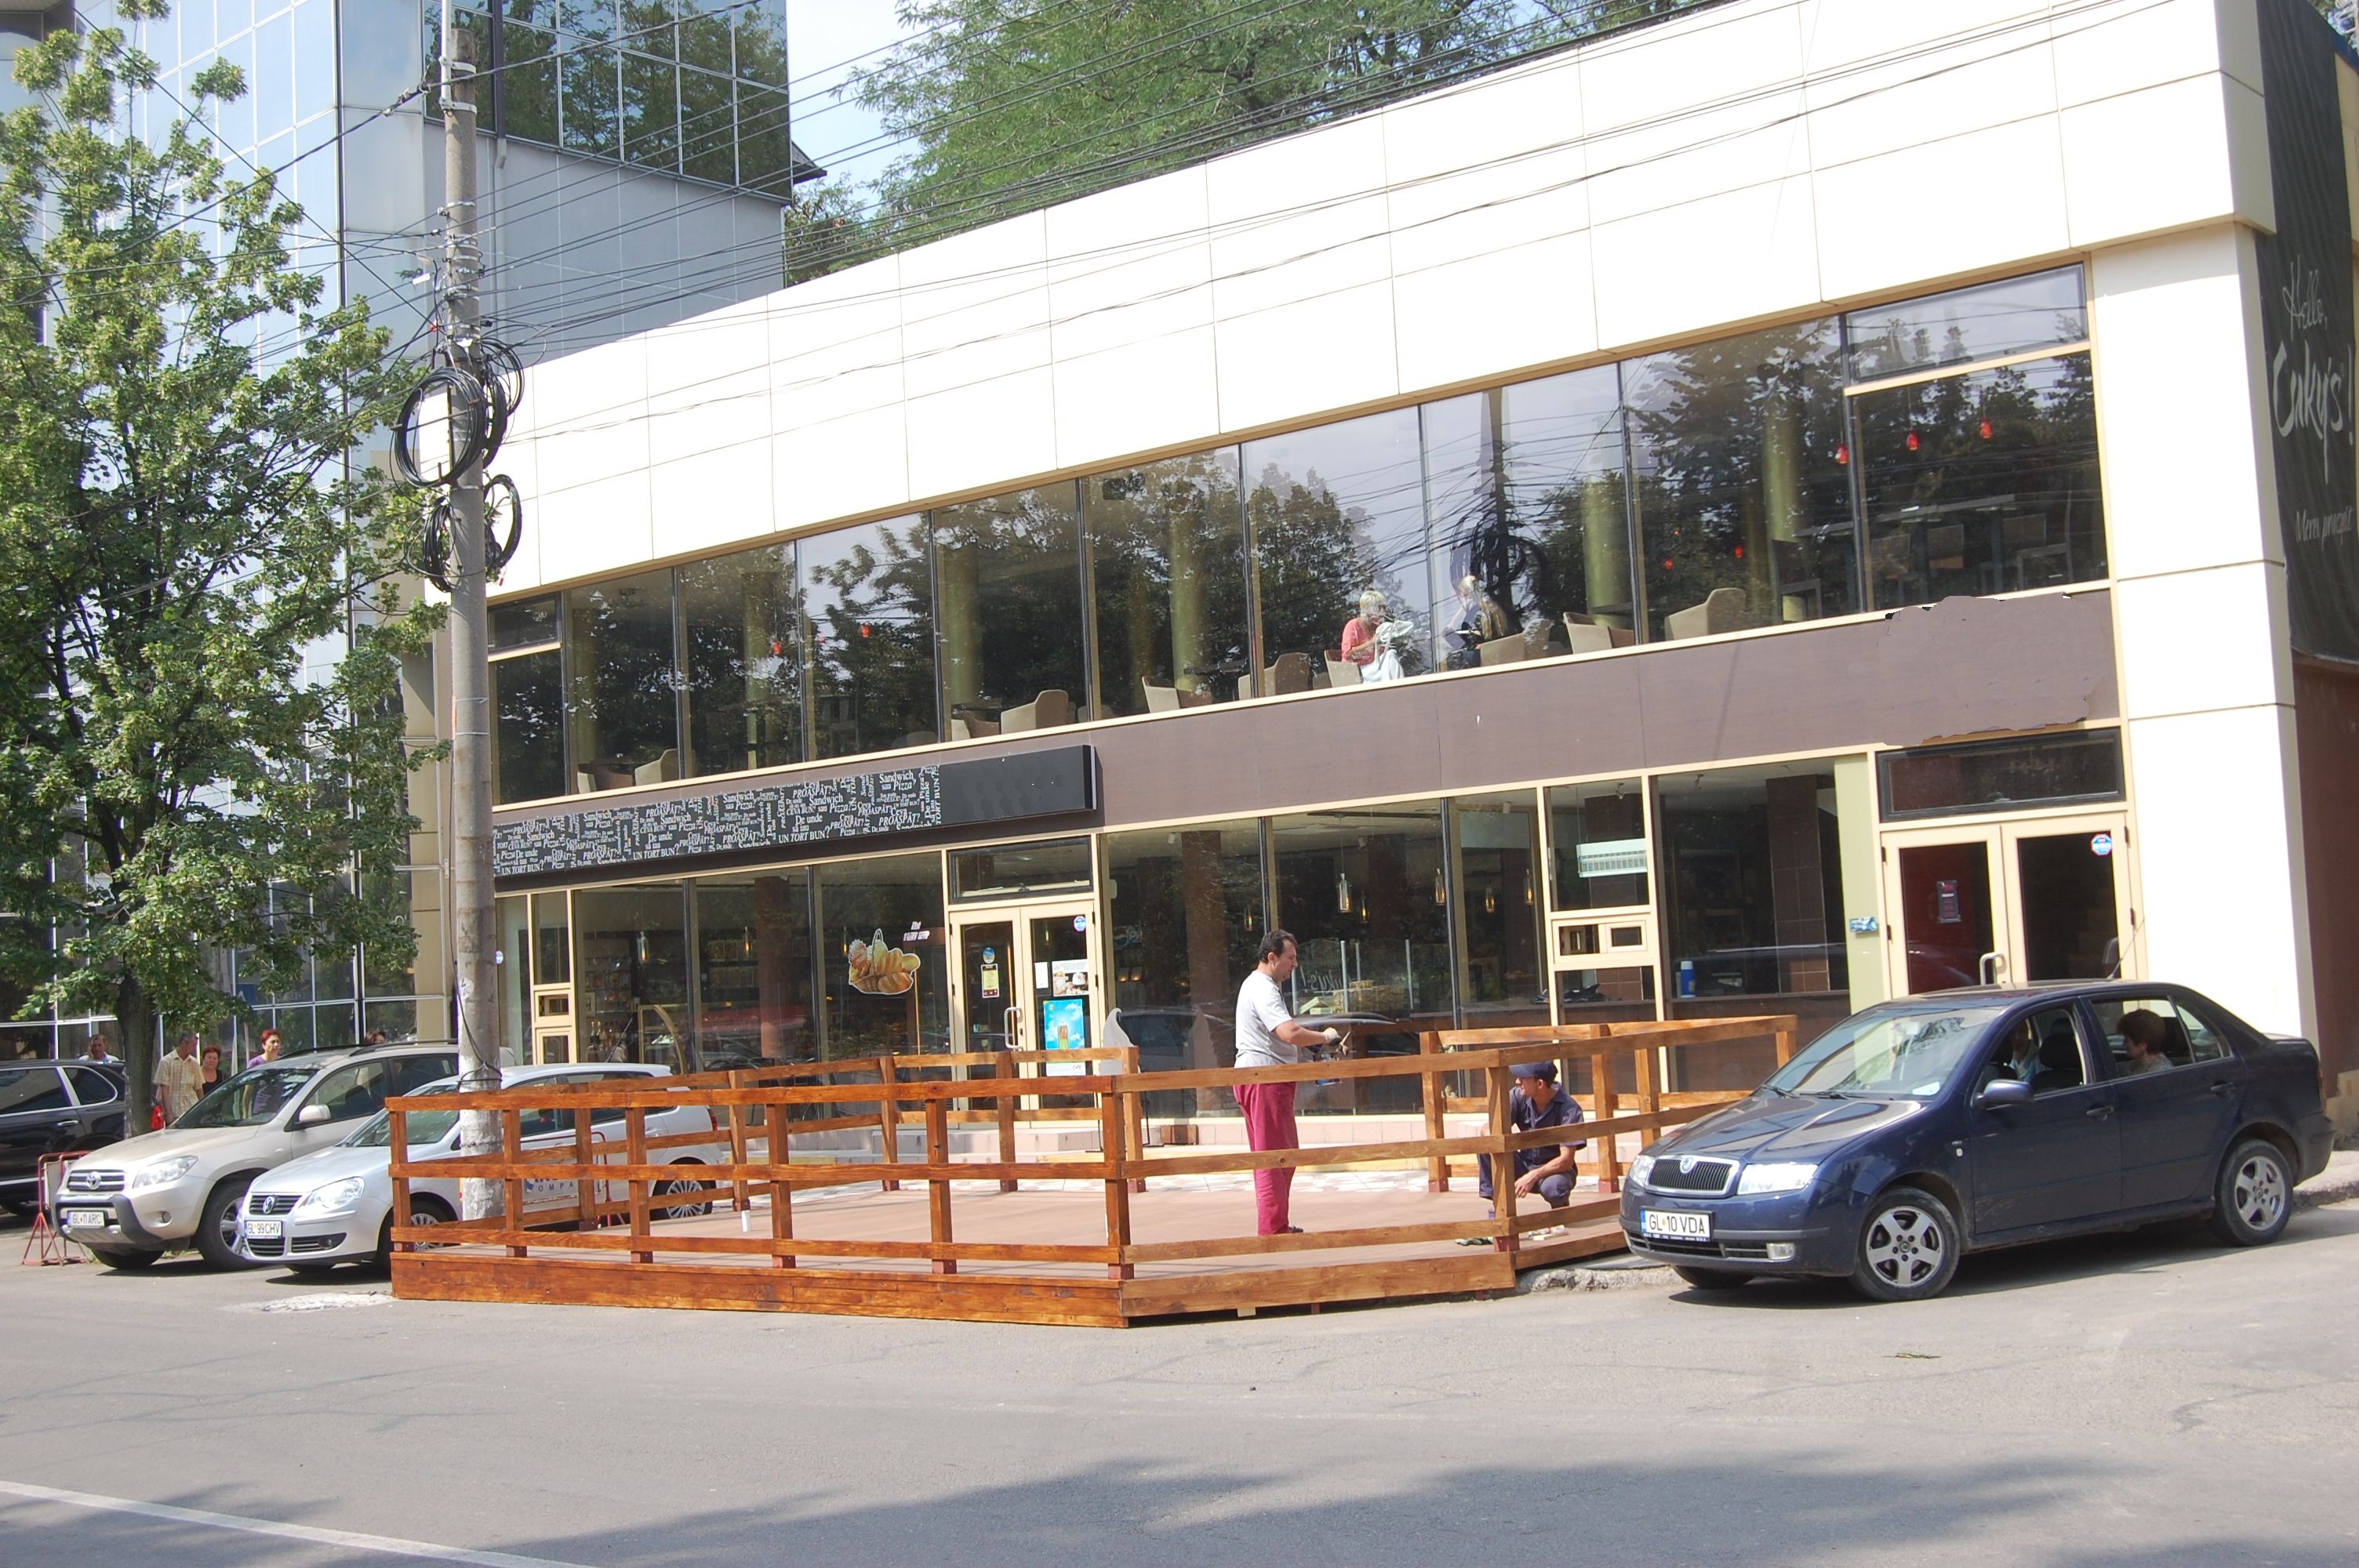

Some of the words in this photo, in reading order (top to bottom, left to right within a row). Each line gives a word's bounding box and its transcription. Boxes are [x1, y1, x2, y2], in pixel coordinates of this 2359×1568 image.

[879, 769, 914, 784] Sandwich
[809, 792, 843, 807] Sandwich
[778, 834, 789, 844] UN
[791, 832, 809, 842] TORT
[633, 851, 642, 860] UN
[643, 849, 660, 859] TORT
[265, 1222, 280, 1234] CHV
[1649, 1214, 1663, 1231] GL
[1667, 1215, 1677, 1232] 10
[1680, 1216, 1705, 1234] VDA
